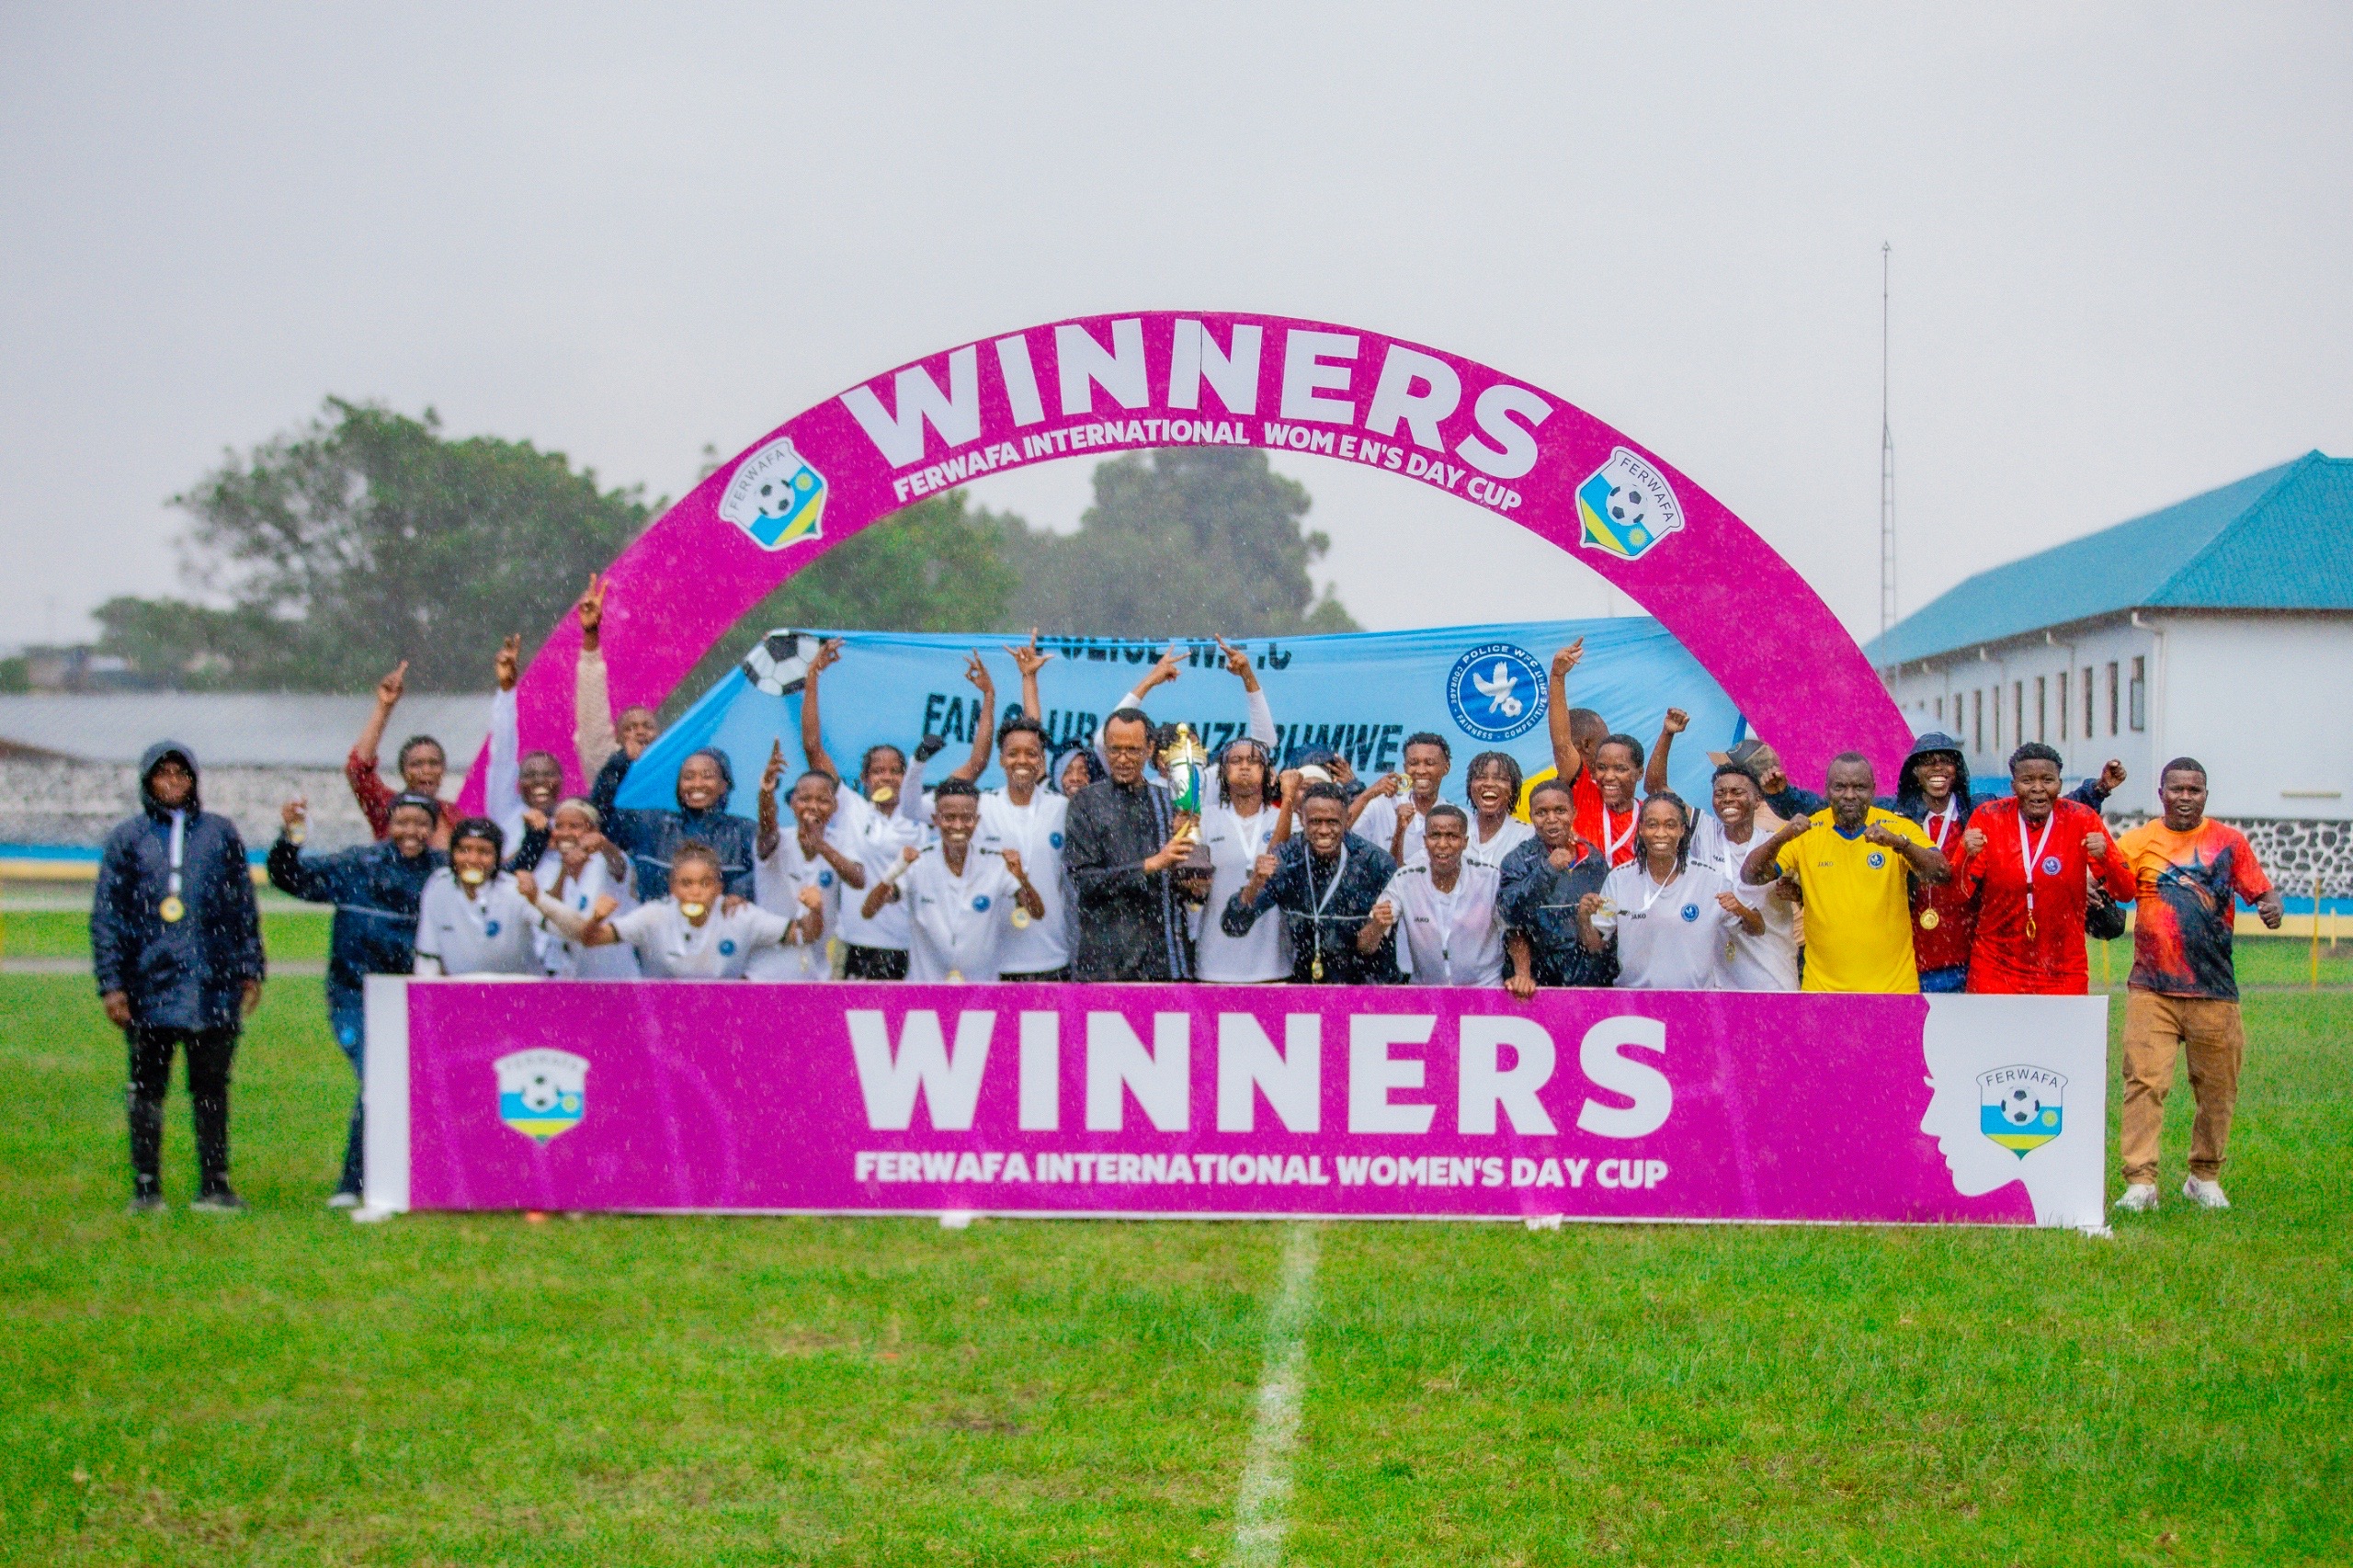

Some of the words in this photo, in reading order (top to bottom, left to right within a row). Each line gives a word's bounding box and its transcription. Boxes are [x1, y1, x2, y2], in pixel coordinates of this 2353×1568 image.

[838, 318, 1554, 479] WINNERS
[729, 449, 786, 511] FERWAFA
[892, 442, 1022, 503] FERWAFA
[1023, 419, 1251, 460] INTERNATIONAL
[1406, 453, 1467, 489] DAY
[1467, 476, 1522, 511] CUP
[1620, 457, 1675, 522] FERWAFA
[1461, 645, 1509, 664] POLICE
[1456, 714, 1493, 740] FAIRNESS
[846, 1009, 1674, 1138] WINNERS
[1986, 1068, 2058, 1088] FERWAFA
[855, 1152, 1031, 1184] FERWAFA
[1036, 1152, 1330, 1186] INTERNATIONAL
[1336, 1154, 1505, 1187] WOMEN'S
[1510, 1157, 1590, 1188] DAY
[1596, 1158, 1668, 1189] CUP
